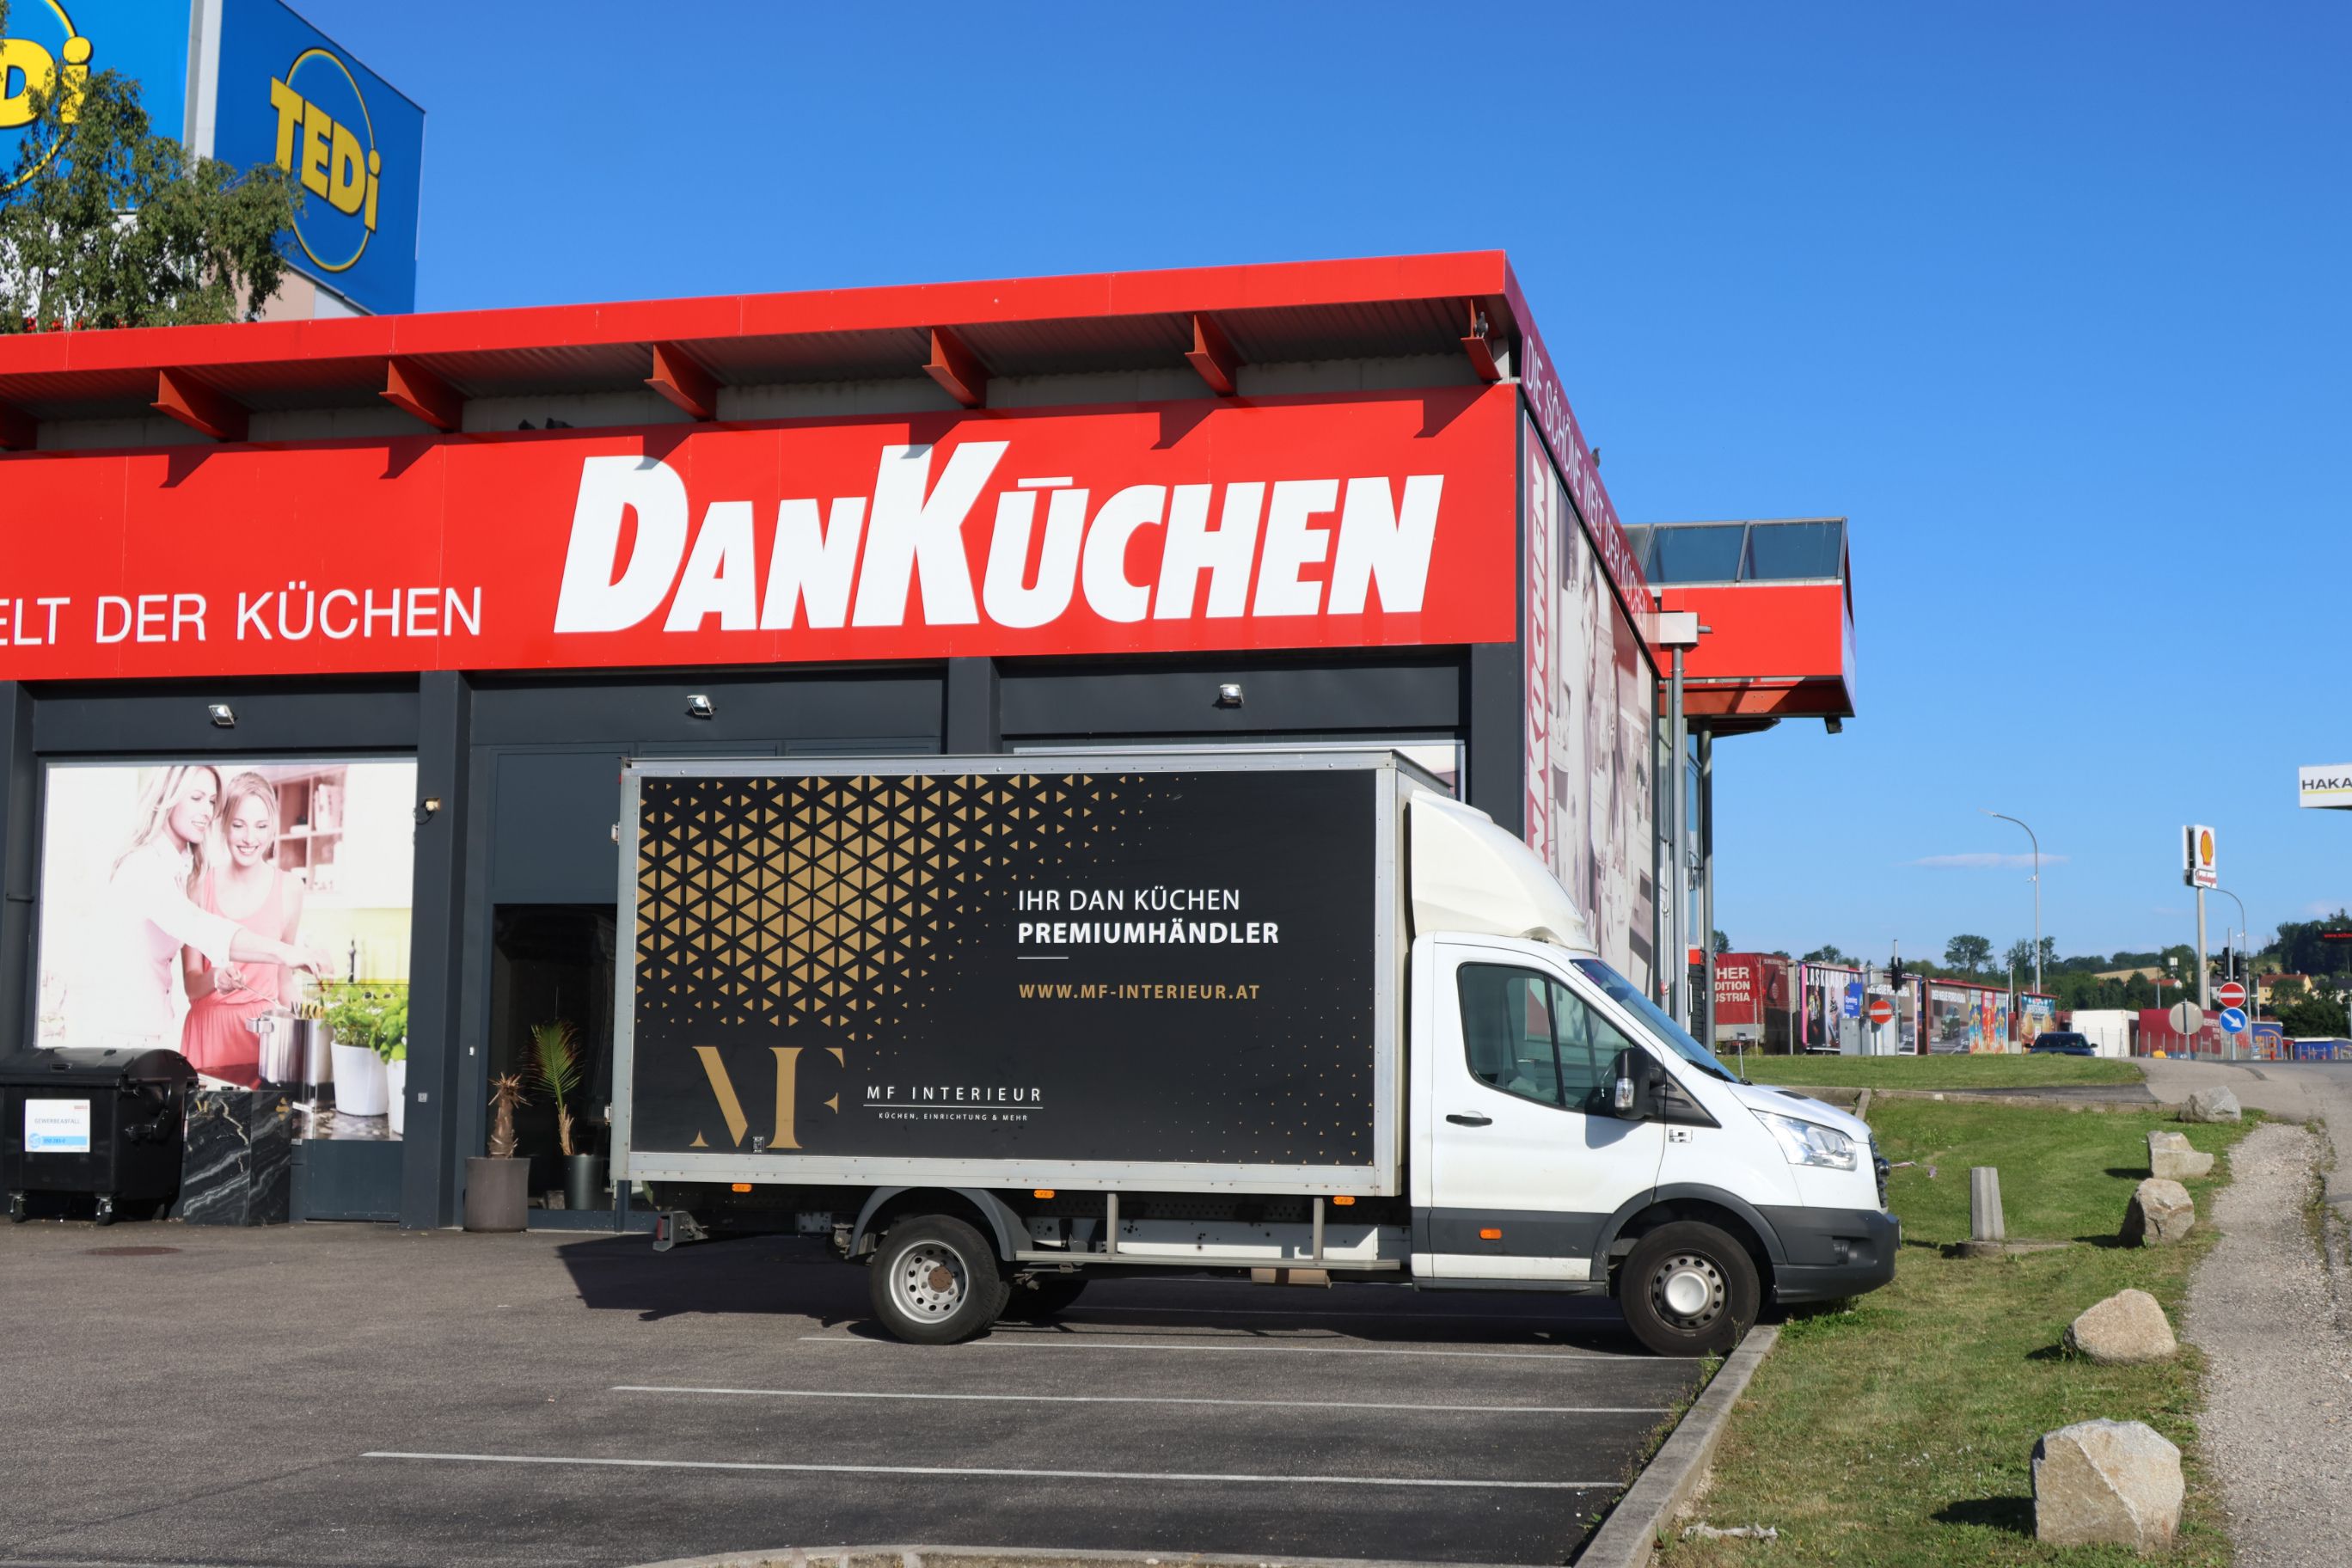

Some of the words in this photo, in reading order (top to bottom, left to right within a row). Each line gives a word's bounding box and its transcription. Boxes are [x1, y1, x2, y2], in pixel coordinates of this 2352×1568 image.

[1526, 334, 1544, 413] DIE
[1545, 380, 1582, 499] SCHÖNE
[1584, 462, 1604, 541] WELT
[1605, 523, 1620, 579] DER
[95, 593, 207, 644] DER
[236, 580, 481, 640] KÜCHEN
[2302, 777, 2352, 790] HAKA
[1019, 890, 1060, 911] IHR
[1069, 889, 1124, 911] DAN
[1135, 885, 1240, 911] KÜCHEN
[1018, 917, 1279, 944] PREMIUMHÄNDLER
[1019, 984, 1259, 999] WWW.MF-INTERIEUR.AT
[867, 1086, 895, 1099] MF
[912, 1087, 1040, 1101] INTERIEUR
[879, 1112, 918, 1120] KÜCHEN,
